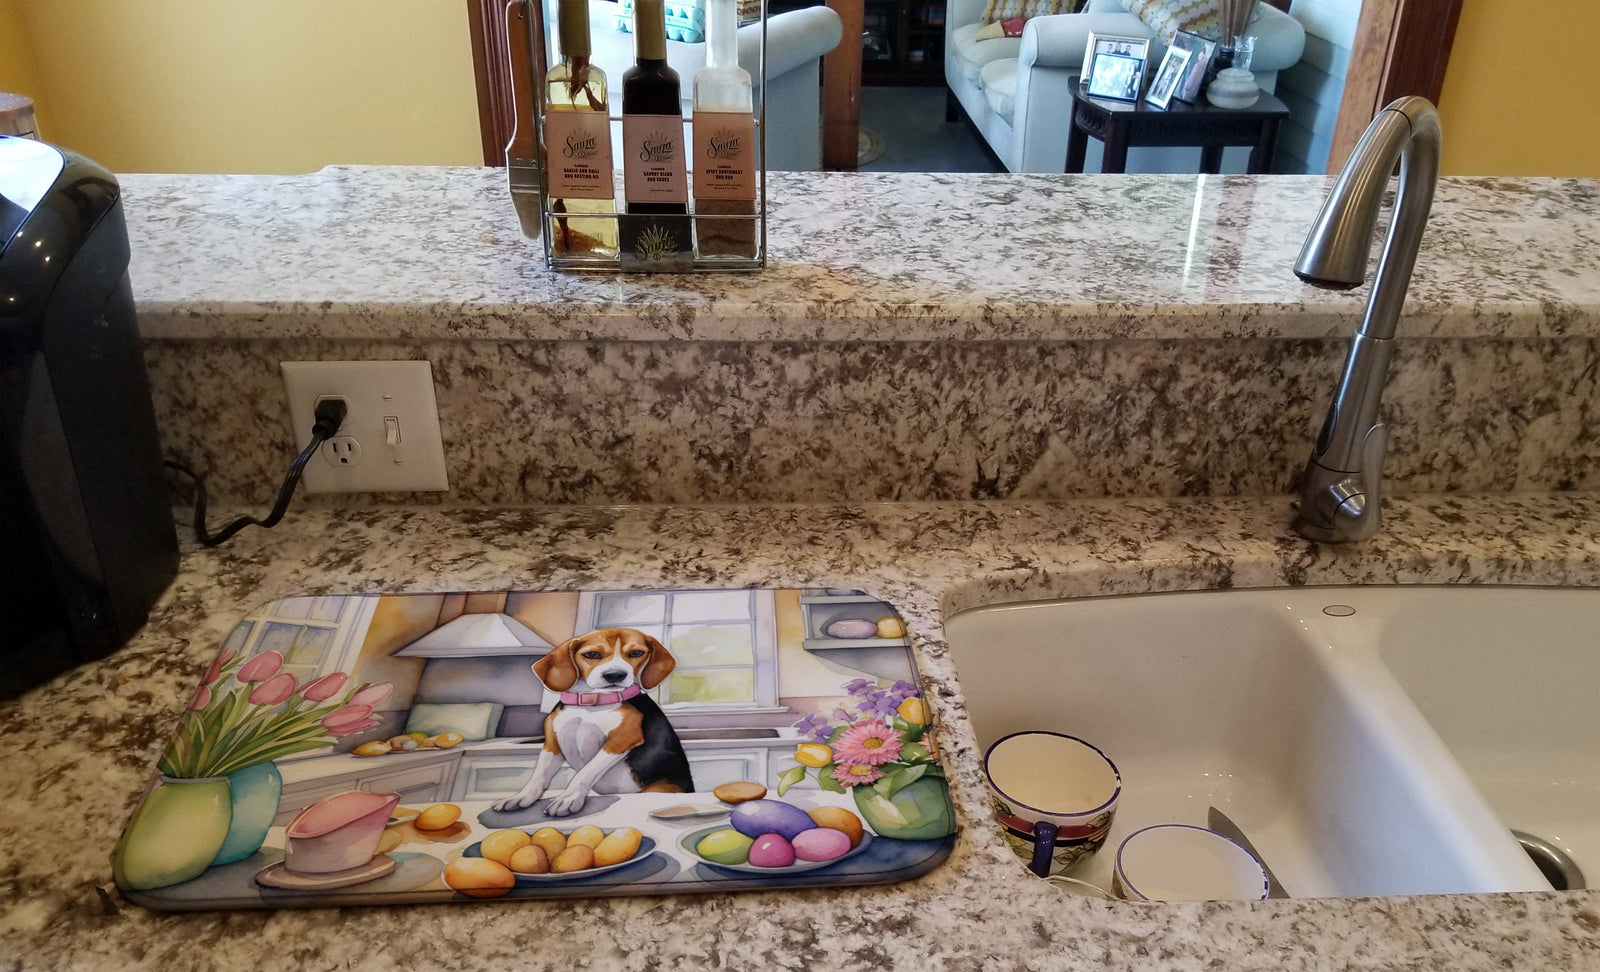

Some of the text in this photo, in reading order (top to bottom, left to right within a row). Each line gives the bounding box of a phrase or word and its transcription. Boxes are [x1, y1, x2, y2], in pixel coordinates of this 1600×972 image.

[563, 136, 597, 158] Sauza
[640, 140, 673, 161] Sauza
[707, 136, 739, 158] Sauza
